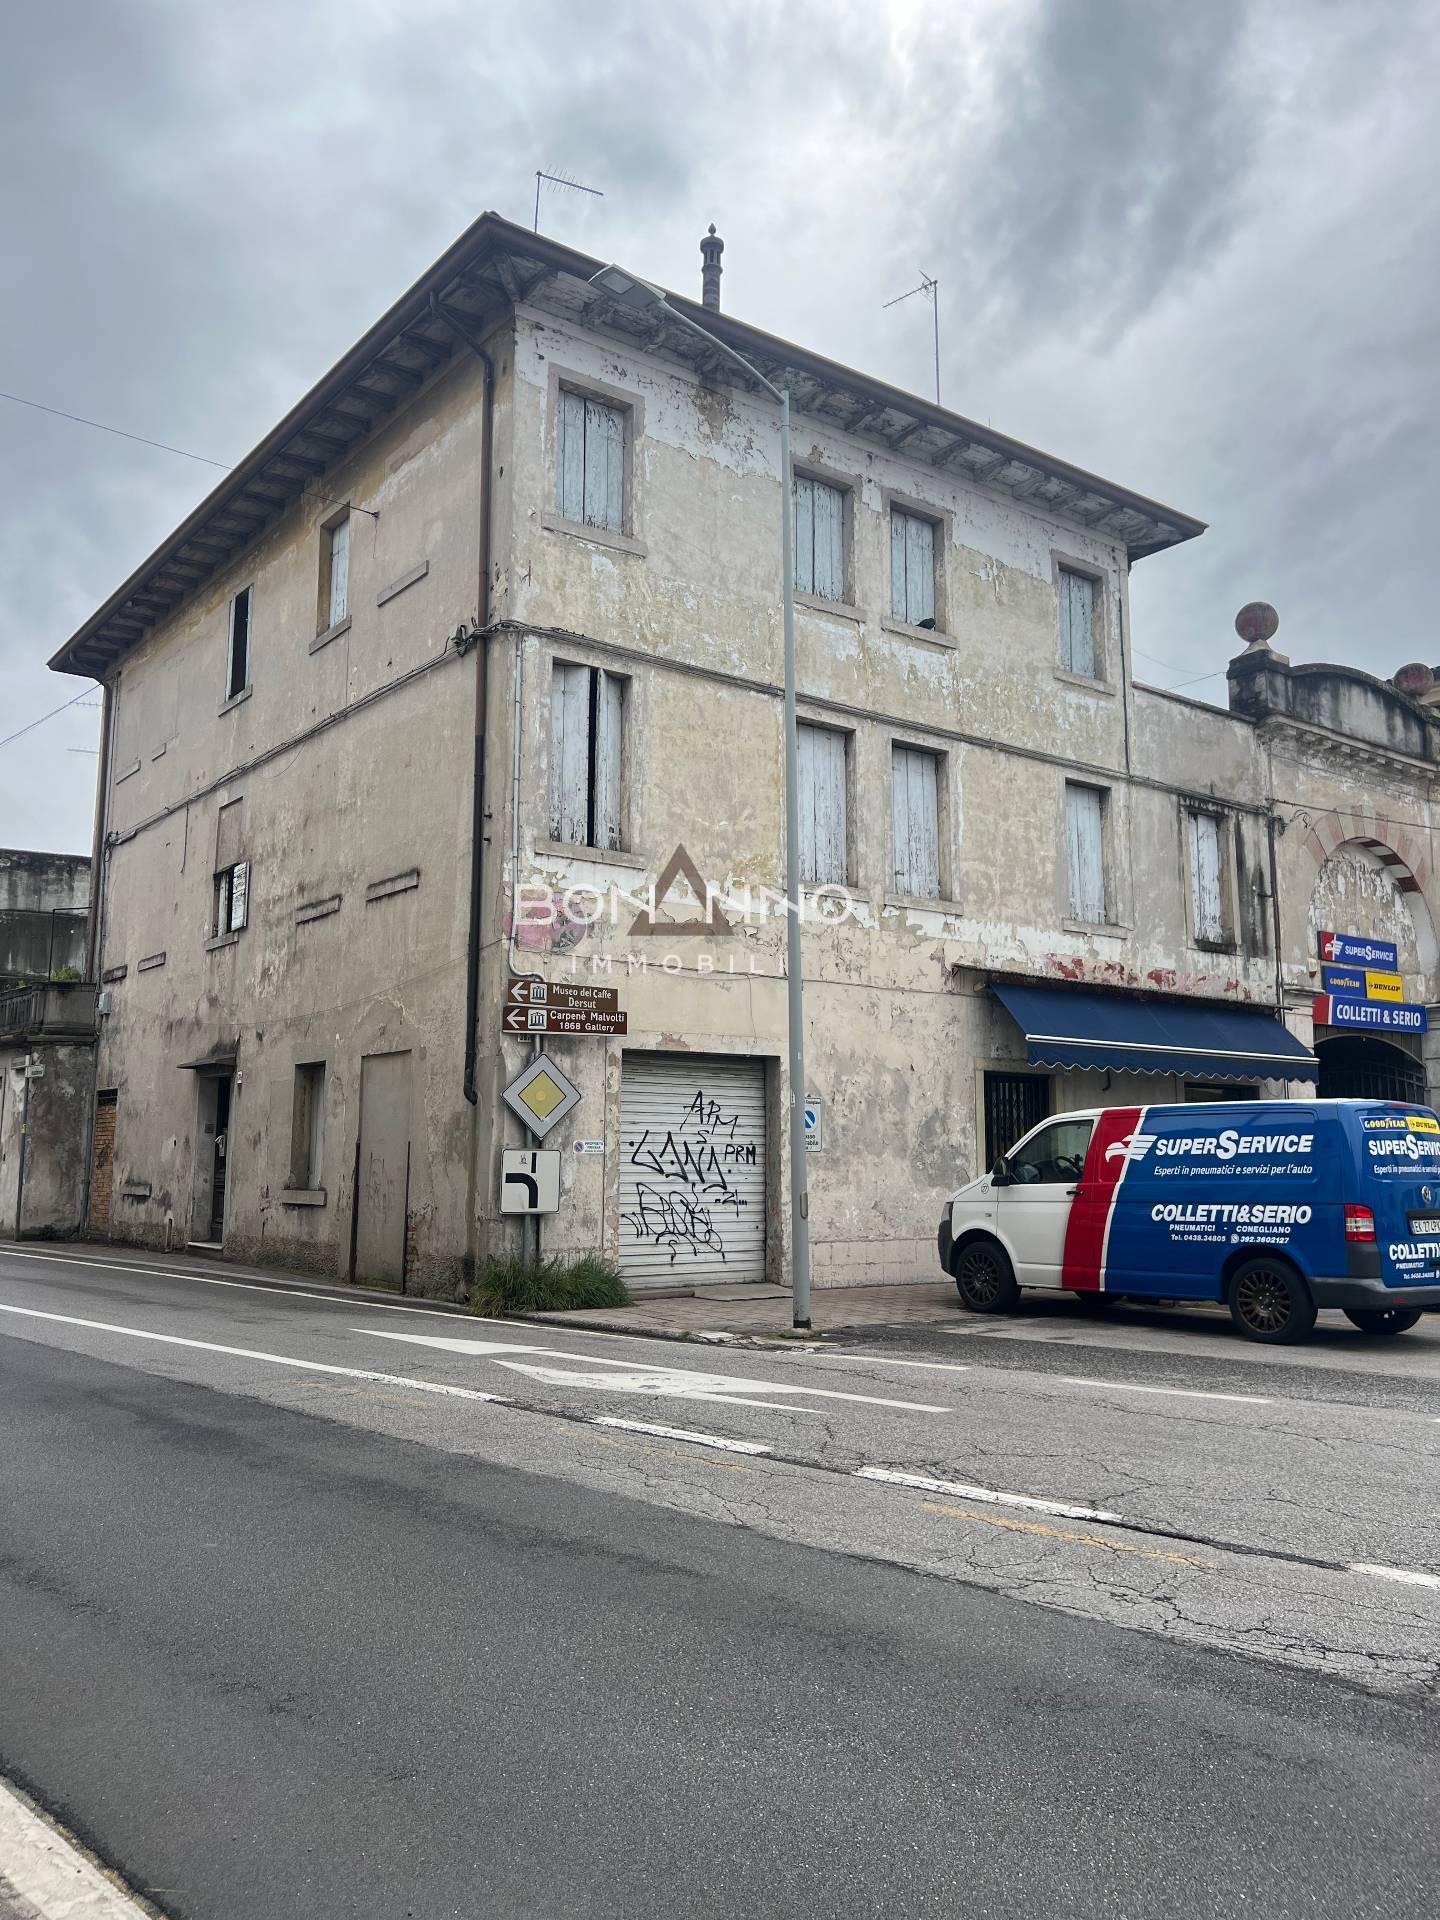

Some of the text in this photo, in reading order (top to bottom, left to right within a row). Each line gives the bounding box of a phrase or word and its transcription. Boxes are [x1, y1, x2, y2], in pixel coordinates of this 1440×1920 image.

[1345, 946, 1394, 961] SUPERSERVICE
[553, 985, 578, 995] Museo
[580, 987, 592, 997] del
[568, 997, 596, 1008] Dersut
[550, 1010, 625, 1022] Carpenè Malvolti
[1337, 1005, 1421, 1027] COLLETTI & SERIO
[560, 1022, 614, 1032] 1868 Gallery
[1364, 1118, 1406, 1129] GOODYEAR
[1156, 1130, 1314, 1159] SUPERSERVICE
[1154, 1163, 1313, 1177] Esperti in pneumatici e servizi per l'auto
[1151, 1204, 1312, 1224] COLLETTI&SERIO
[1169, 1224, 1216, 1232] PNEUMATICI
[1236, 1225, 1291, 1234] CONEGLIANO
